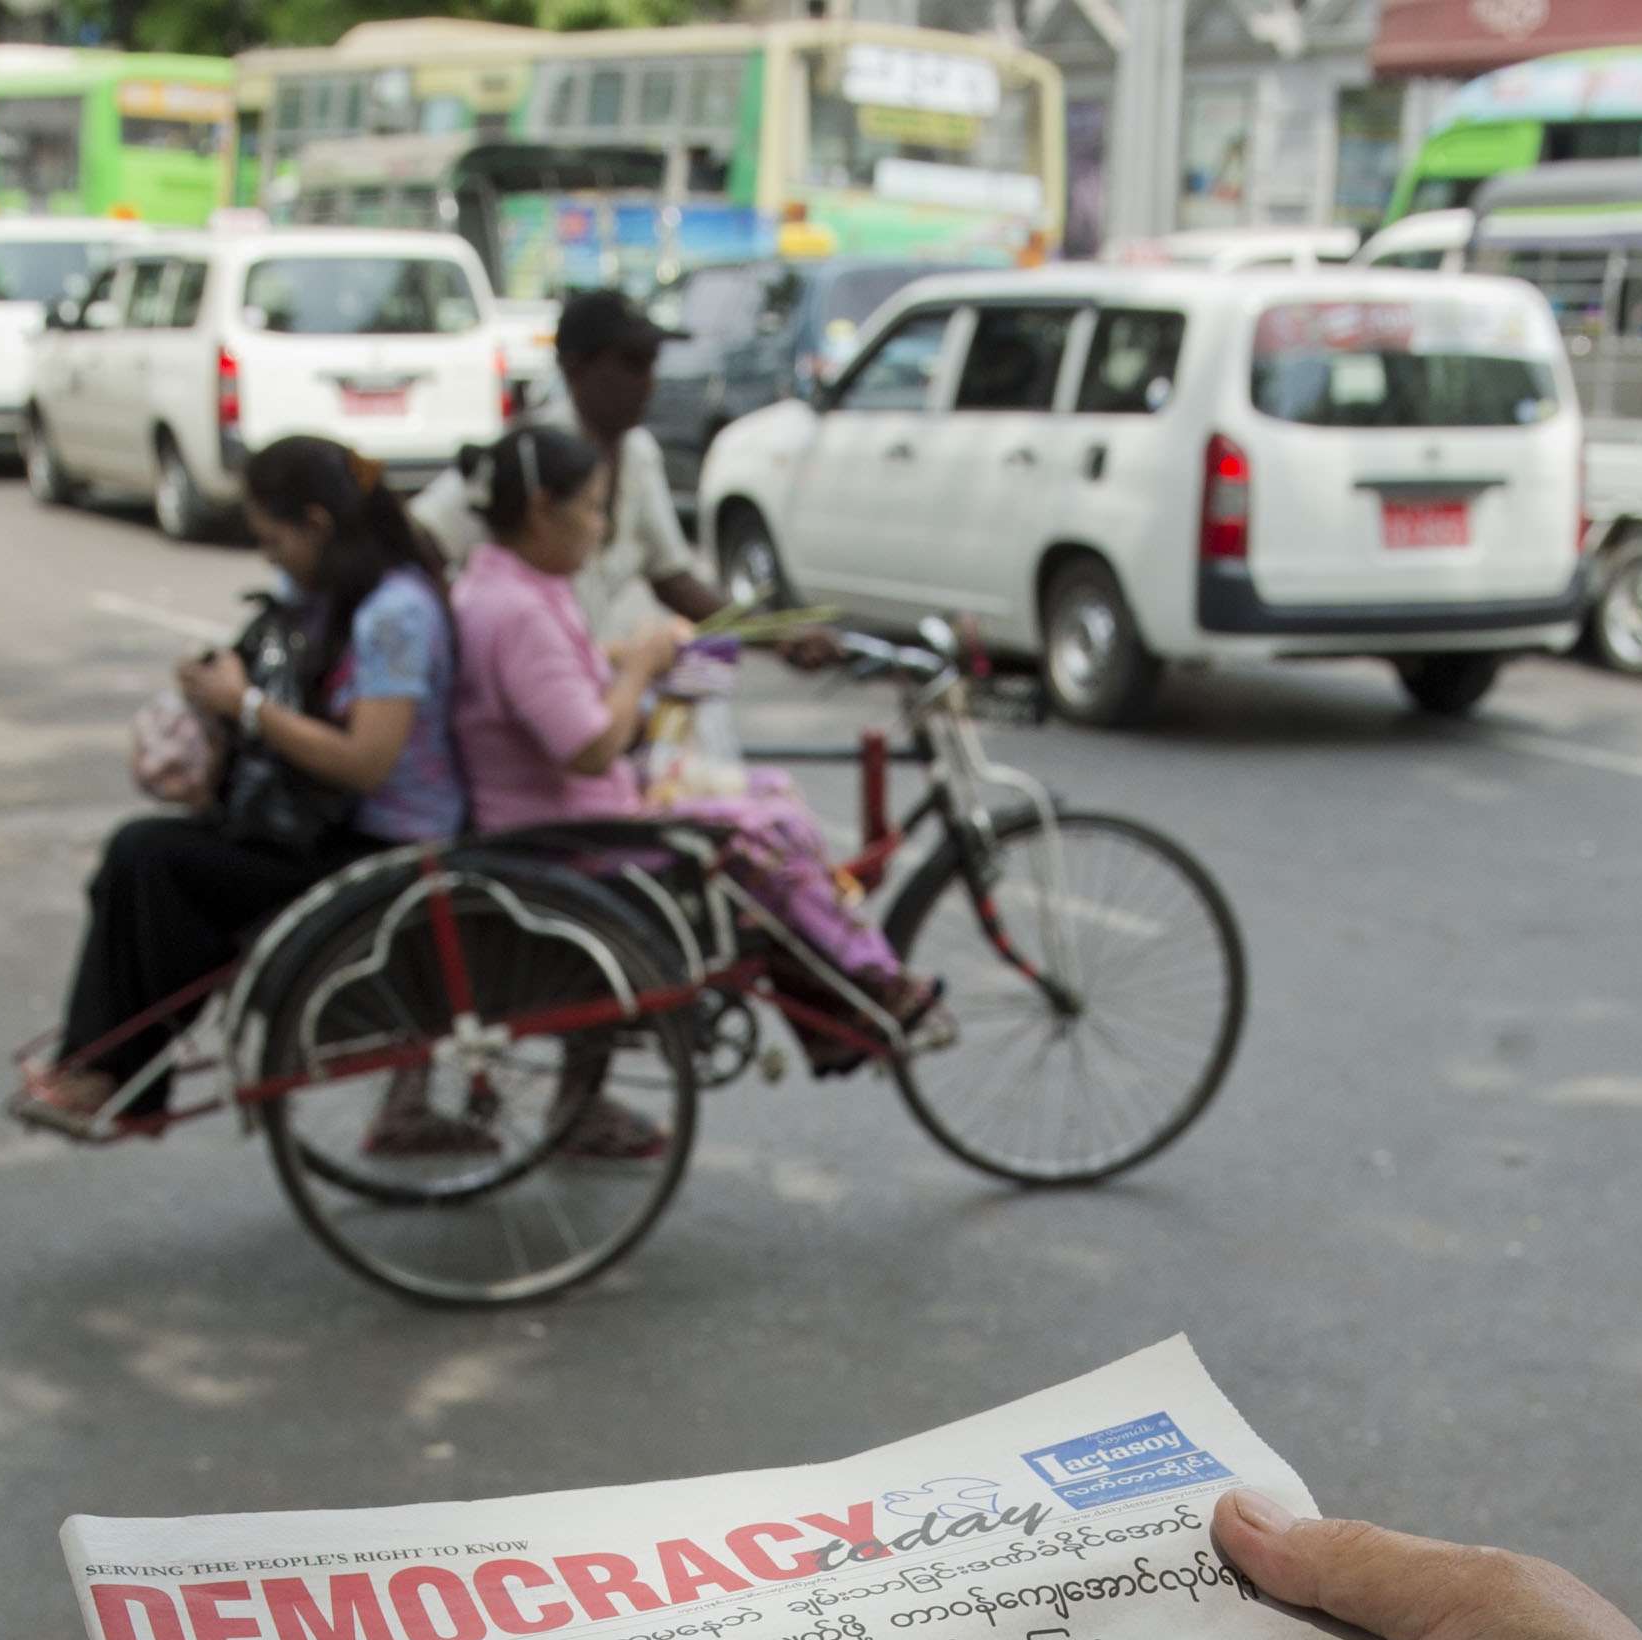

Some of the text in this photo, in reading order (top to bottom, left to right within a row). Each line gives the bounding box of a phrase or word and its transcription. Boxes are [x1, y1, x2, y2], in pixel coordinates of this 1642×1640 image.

[1033, 1430, 1182, 1485] Lactasoy
[85, 1541, 527, 1577] SERVING THE PEOPLE'S RIGHT TO KNOW
[787, 1504, 1203, 1615] ချမ်းသာခြင်းဒဏ်ခံနိုင်အောင်
[817, 1501, 1054, 1572] today
